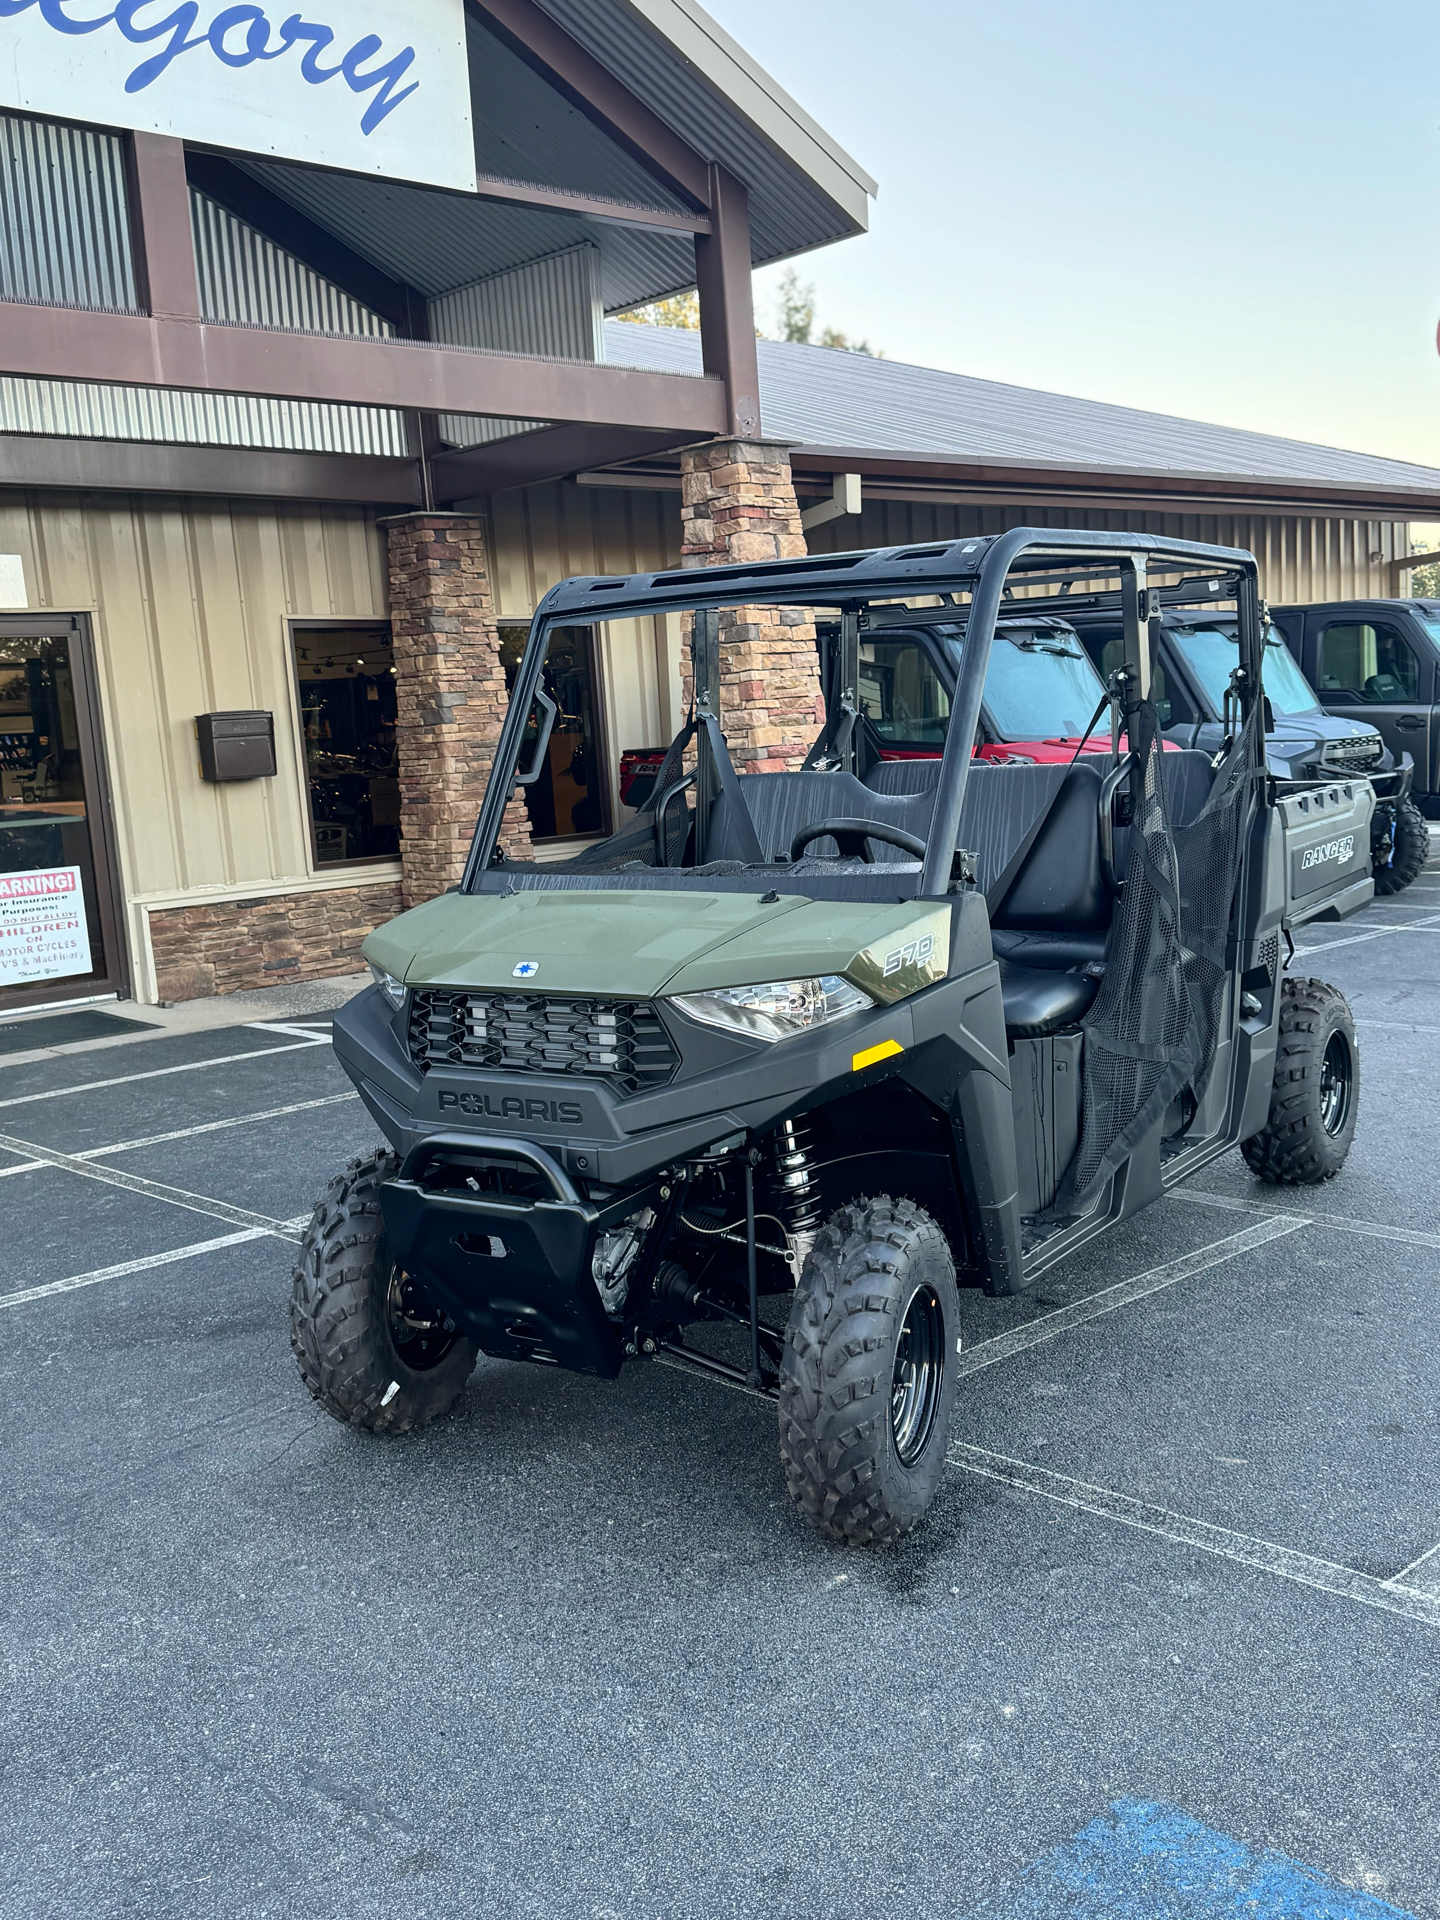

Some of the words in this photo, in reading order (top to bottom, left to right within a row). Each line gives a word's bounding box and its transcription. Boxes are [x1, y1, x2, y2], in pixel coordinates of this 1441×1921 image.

[1301, 835, 1354, 870] RANGER
[1337, 851, 1354, 865] SP
[0, 873, 73, 897] ARNING!
[12, 894, 68, 906] Insurance
[2, 904, 58, 915] Purposes:
[20, 915, 41, 923] NOT
[44, 911, 77, 920] ALLOW
[0, 920, 79, 937] HILDREN
[26, 935, 43, 943] ON
[37, 940, 77, 952] CYCLES
[0, 958, 18, 969] V'S
[33, 952, 84, 964] Machinery
[883, 932, 934, 978] 570
[18, 969, 41, 978] Thank
[438, 1090, 583, 1126] POLARIS
